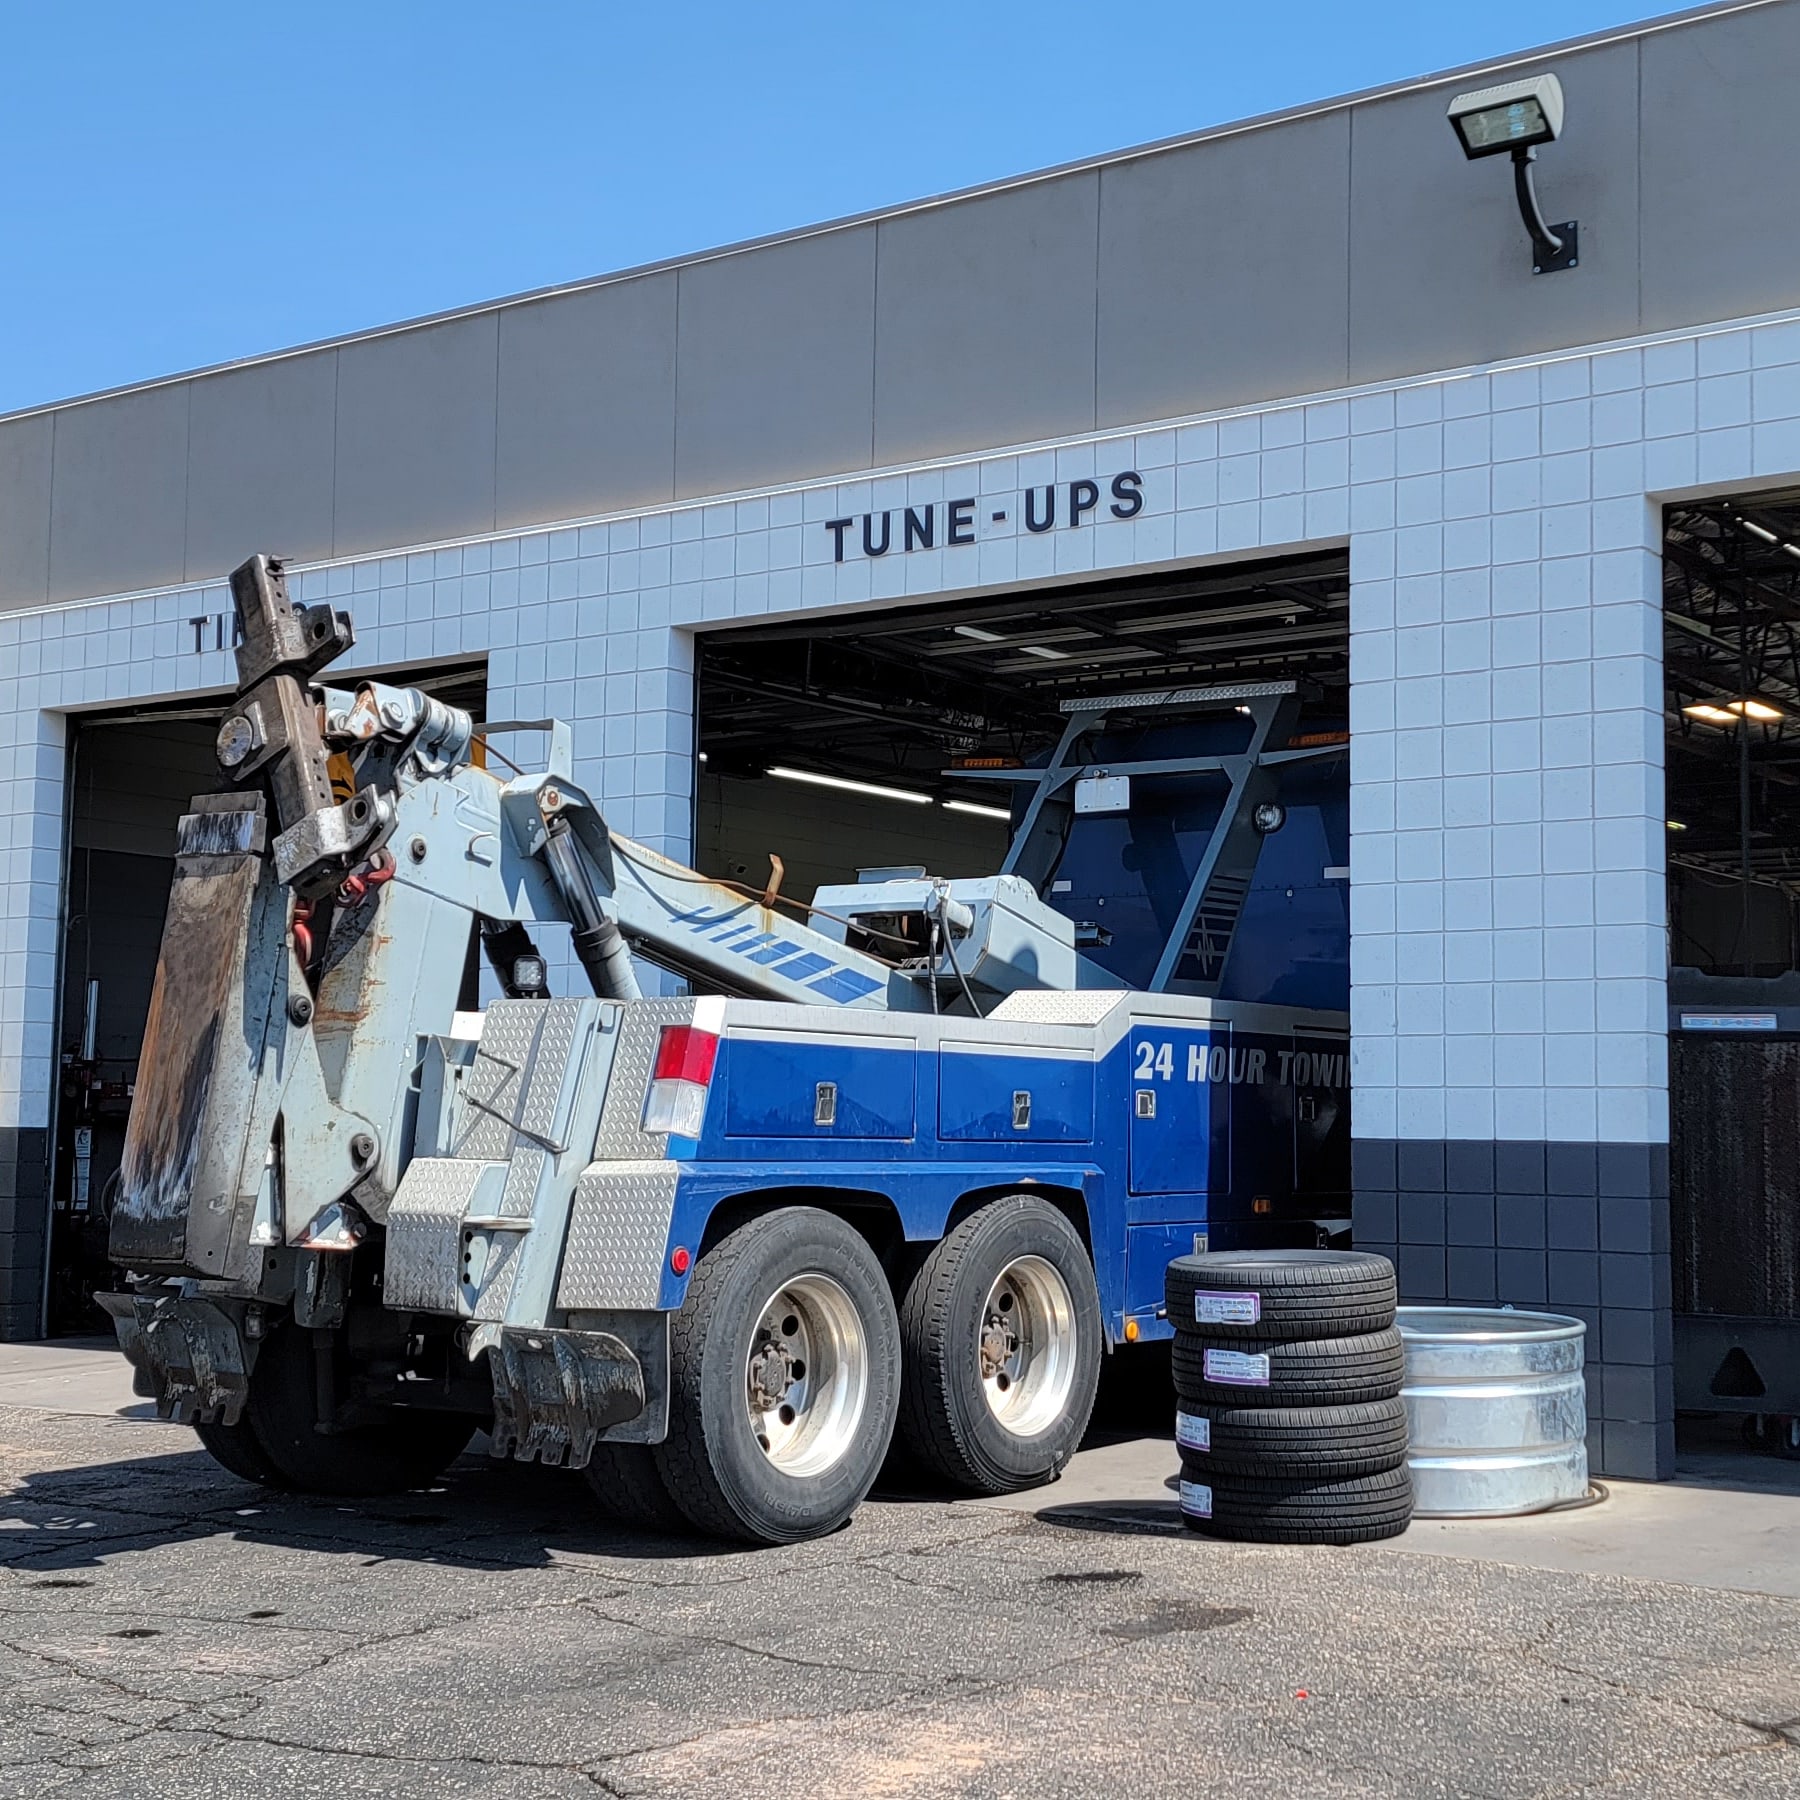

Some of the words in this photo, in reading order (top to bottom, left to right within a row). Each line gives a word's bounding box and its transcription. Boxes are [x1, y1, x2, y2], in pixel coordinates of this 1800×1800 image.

[825, 471, 1144, 562] TUNE-UPS
[1134, 1041, 1174, 1081] 24
[1187, 1044, 1267, 1085] HOUR
